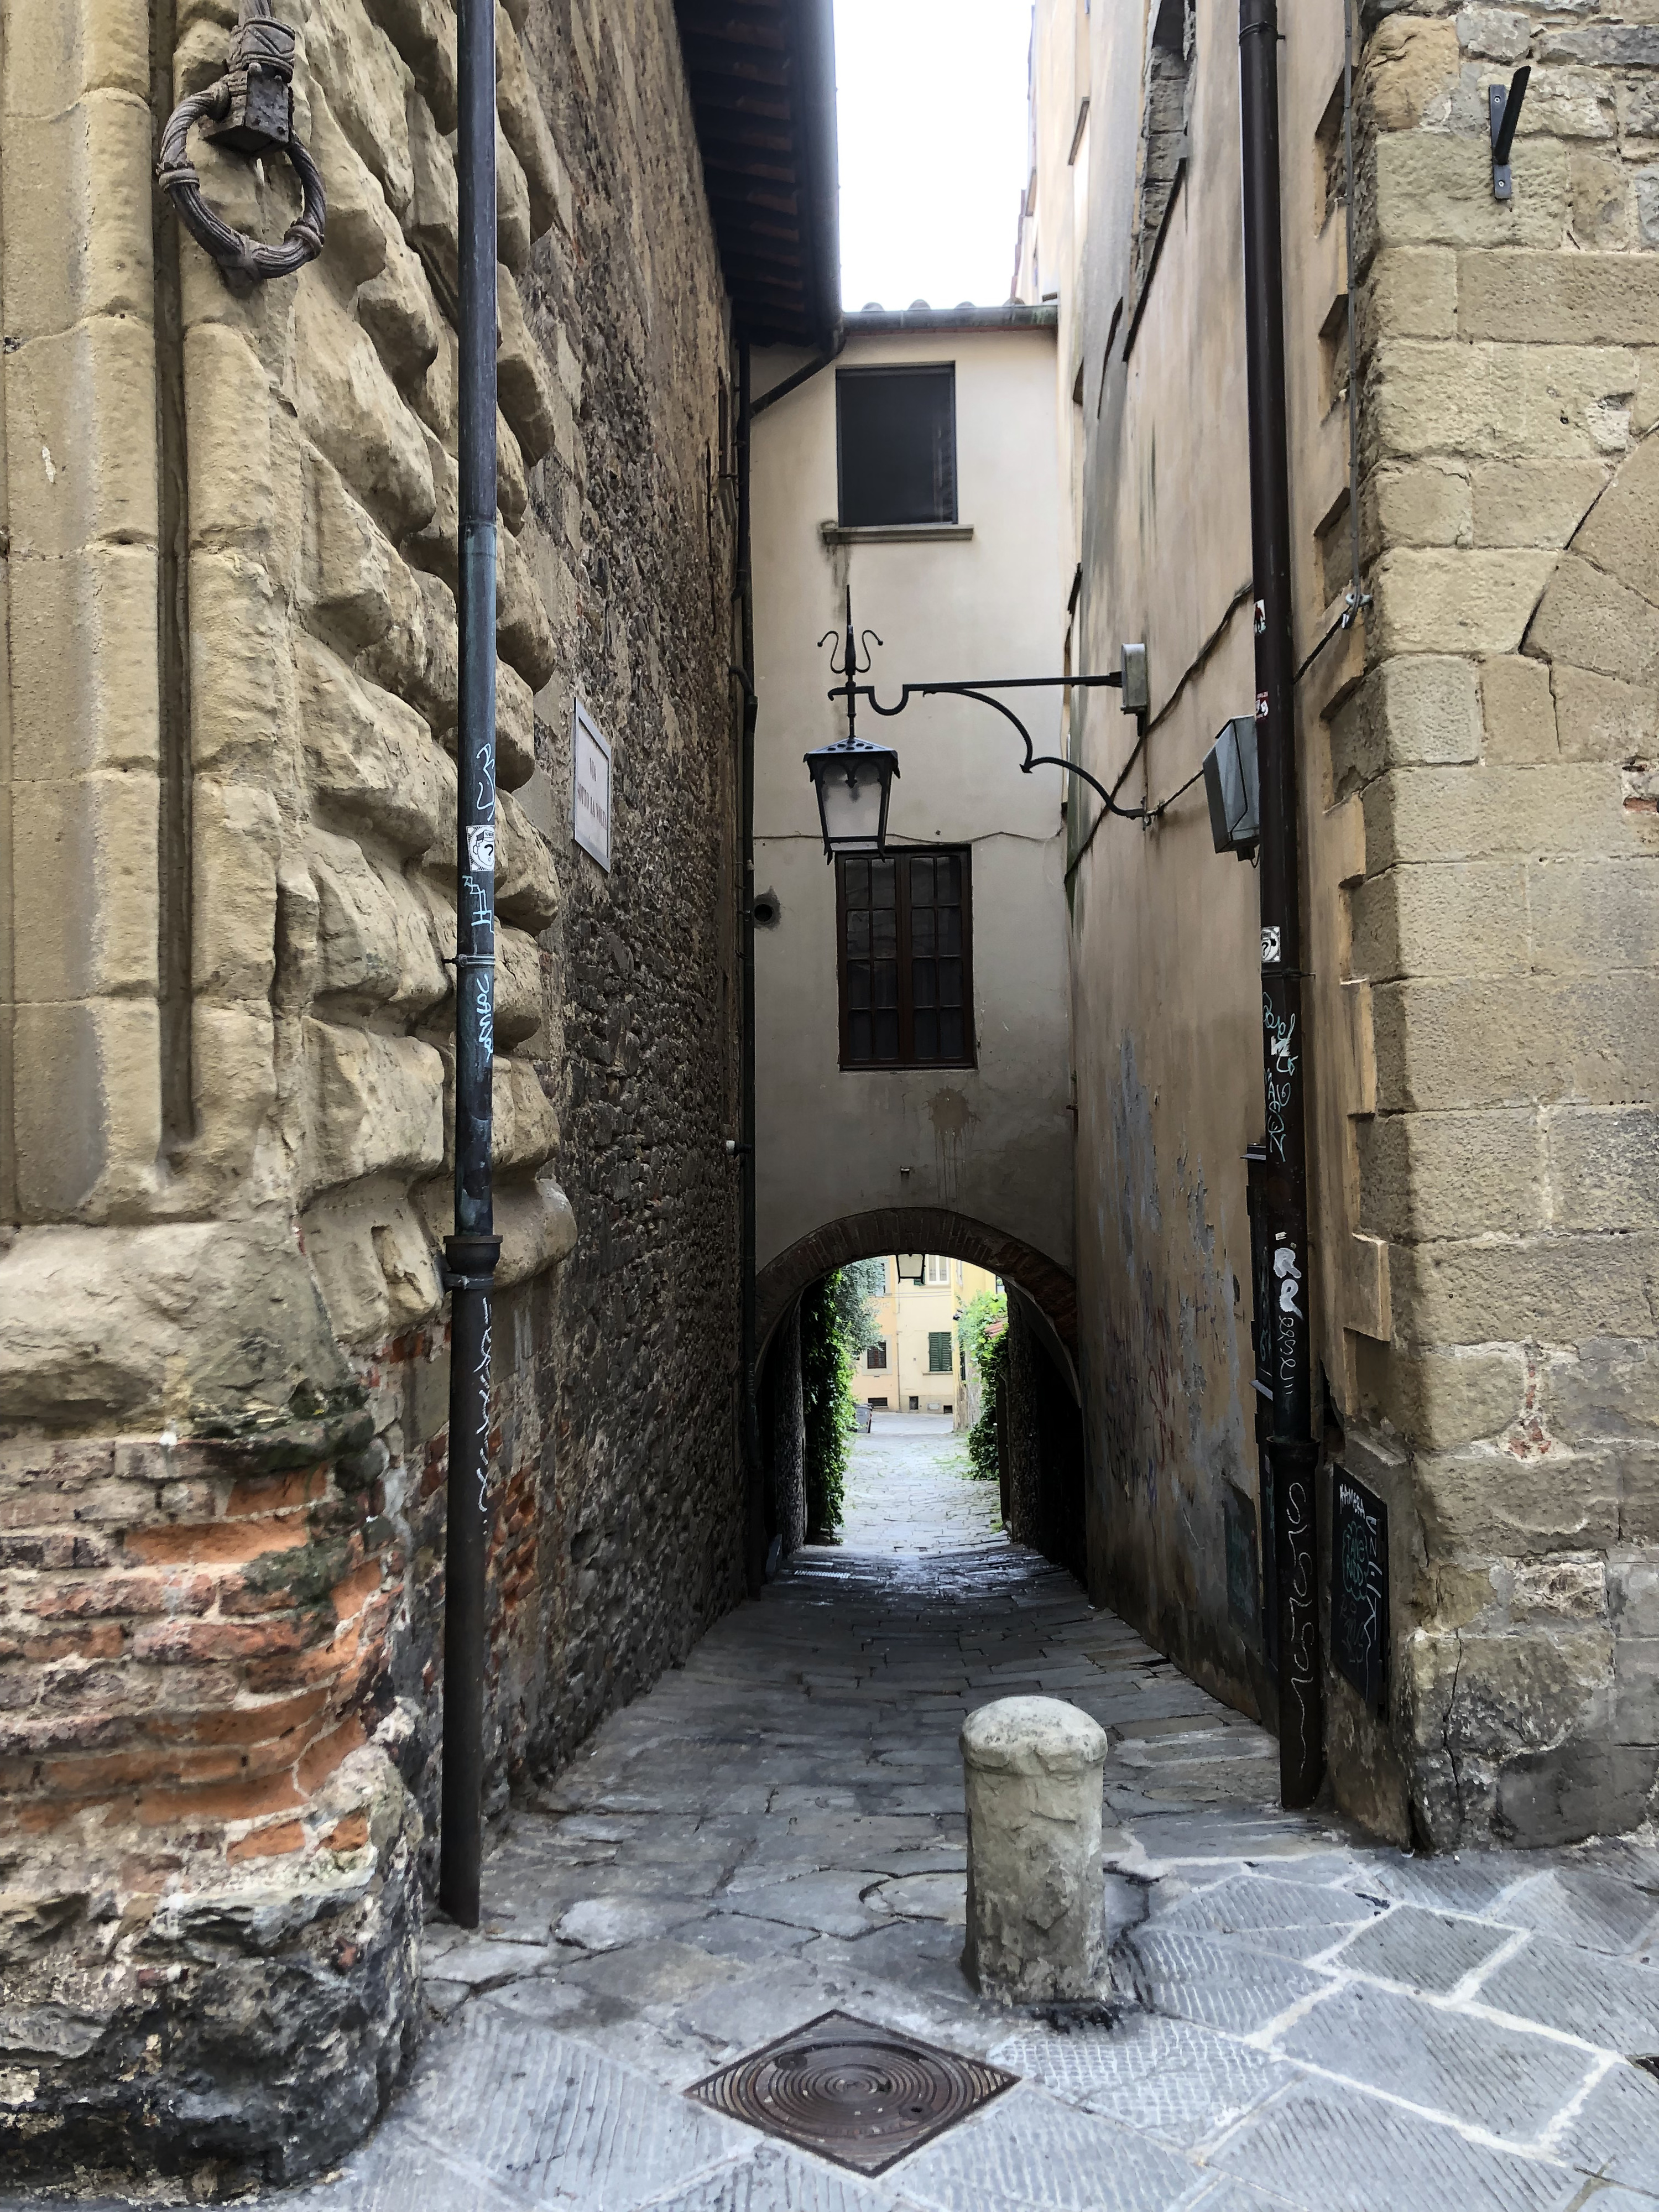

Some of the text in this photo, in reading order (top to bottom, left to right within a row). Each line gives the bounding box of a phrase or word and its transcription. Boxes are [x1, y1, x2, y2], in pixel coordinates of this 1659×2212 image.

[577, 782, 607, 830] SOTTO LA VOLTA
